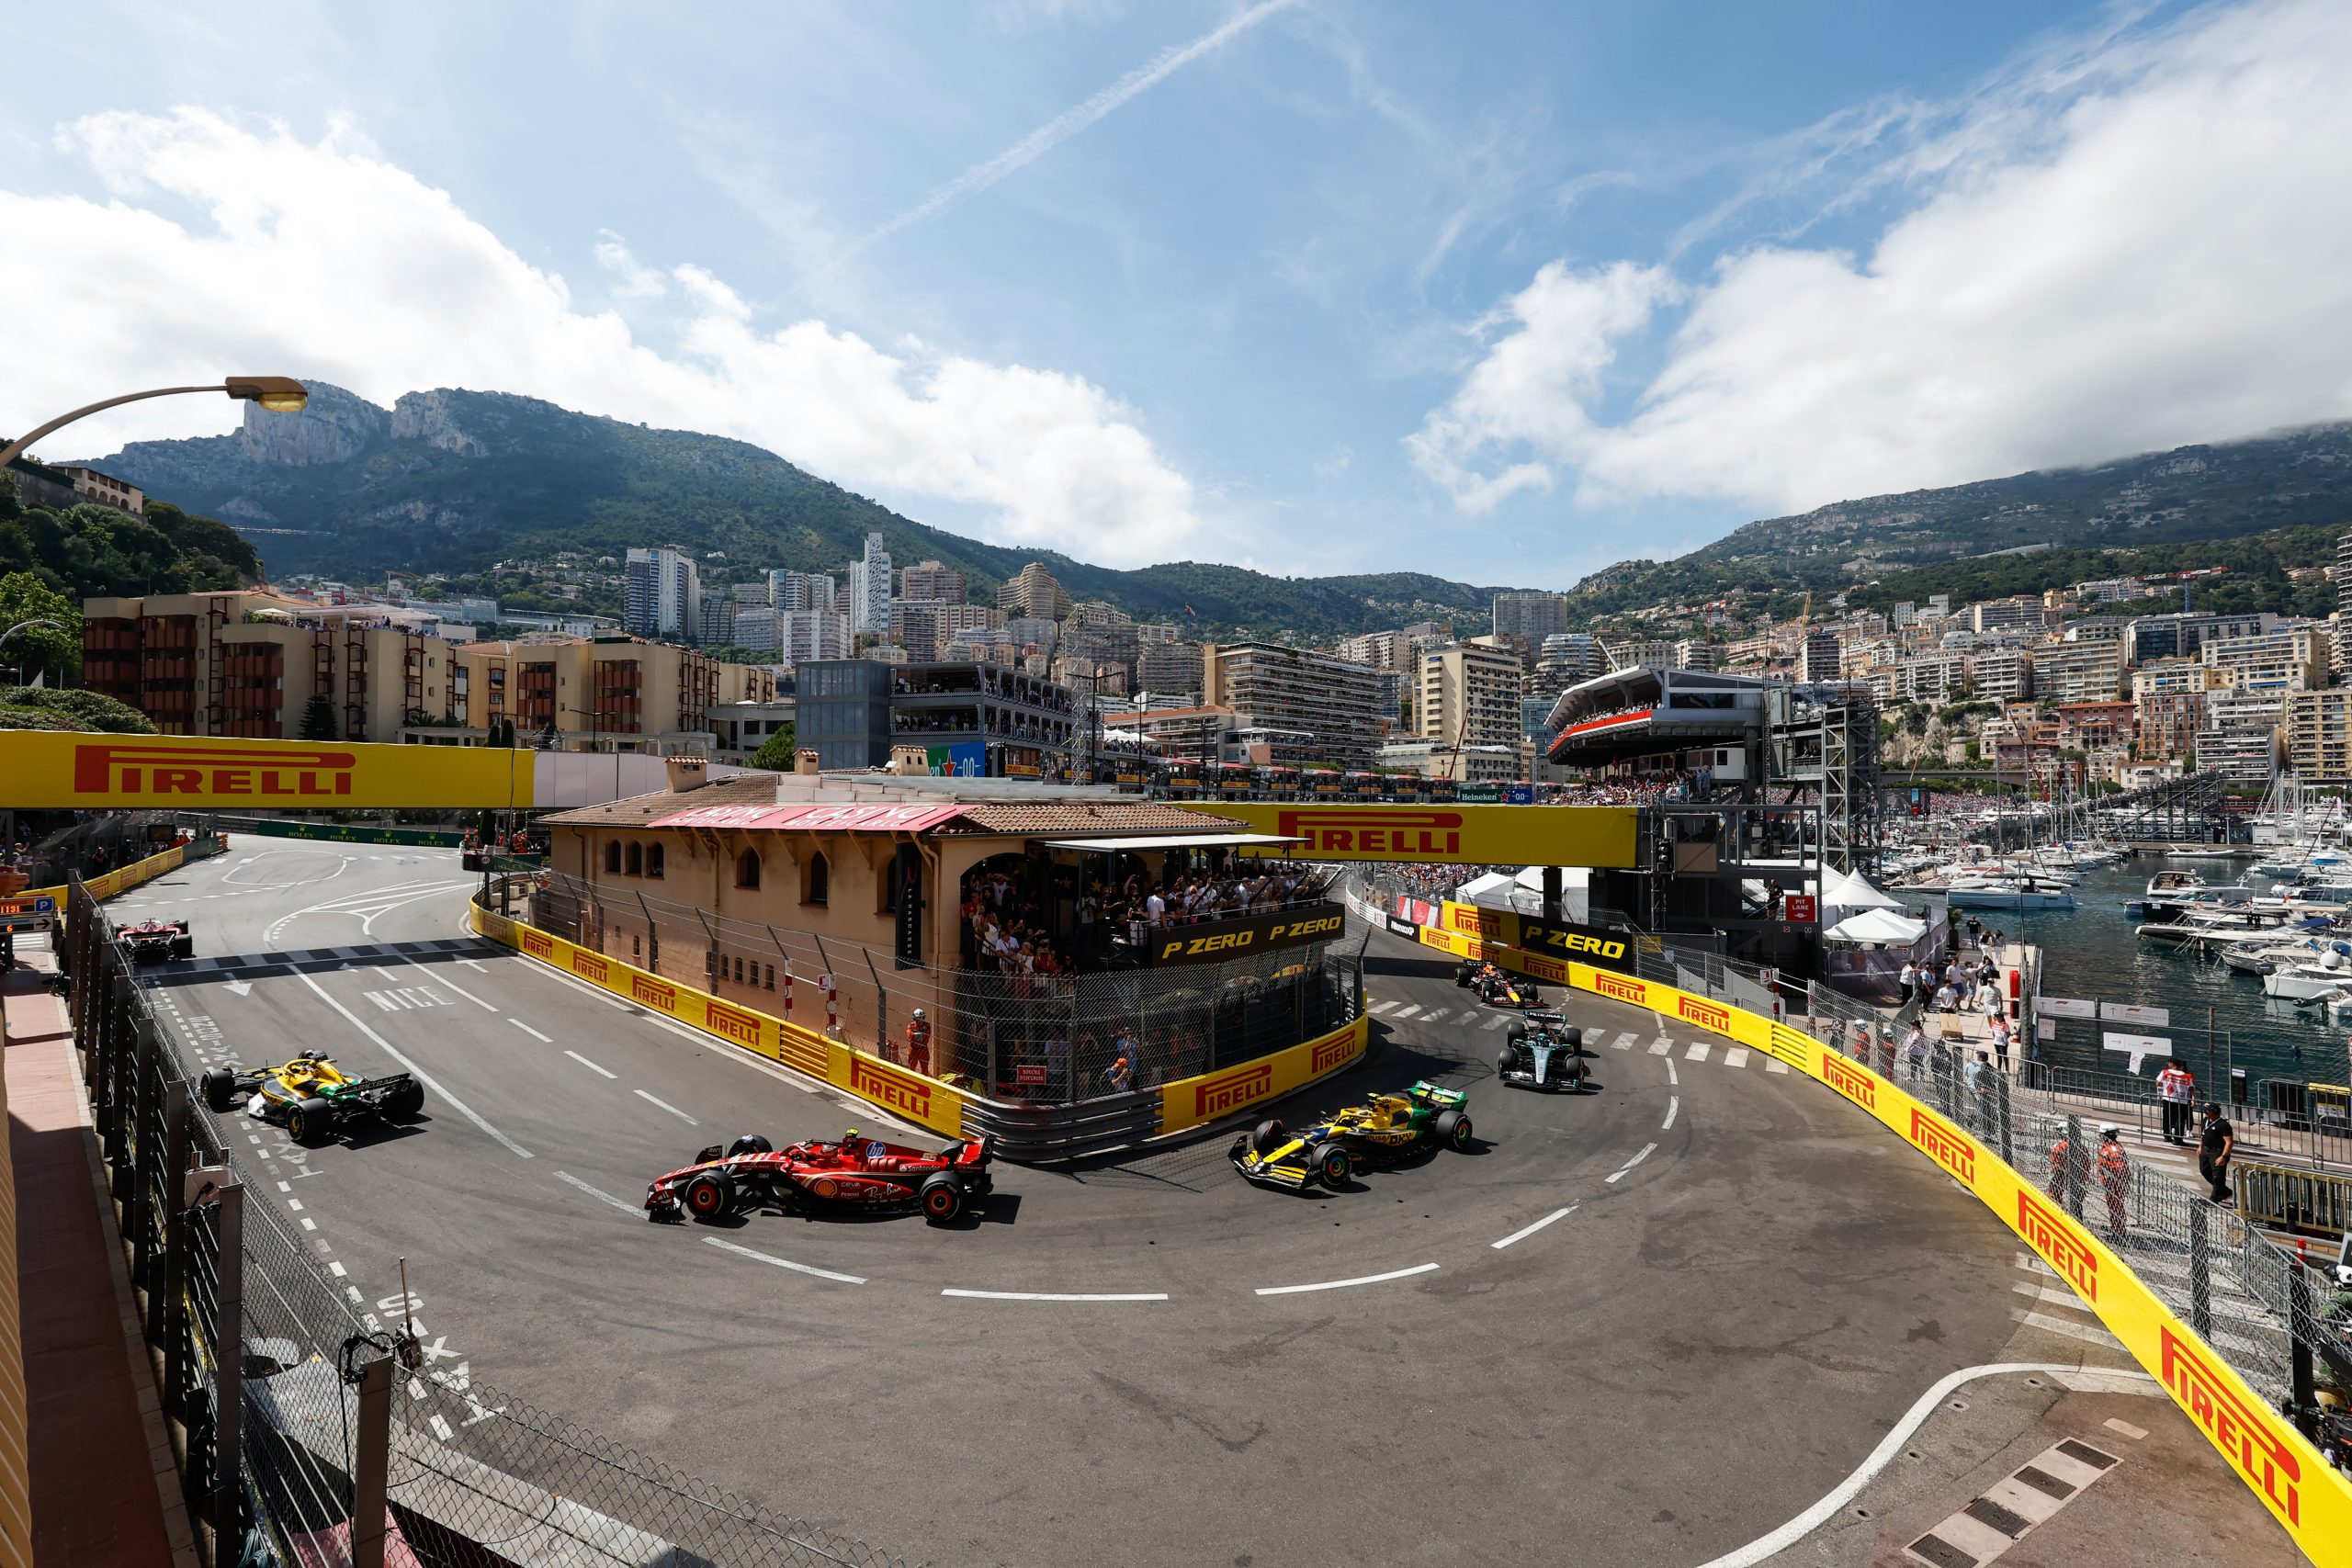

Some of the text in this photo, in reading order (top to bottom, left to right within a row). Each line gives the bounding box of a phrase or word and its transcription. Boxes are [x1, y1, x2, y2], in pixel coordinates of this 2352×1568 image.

[74, 744, 356, 795] PIRELLI
[806, 807, 937, 819] CASINO
[1462, 793, 1498, 801] Heineken
[1279, 811, 1463, 854] PIRELLI
[6, 924, 13, 932] 6
[483, 914, 508, 940] PIRELLI
[1269, 916, 1342, 941] P ZERO
[1427, 931, 1451, 949] PIRELLI
[1455, 908, 1500, 938] PIRELLI
[524, 930, 553, 960] PIRELLI
[1162, 931, 1254, 959] P ZERO
[1525, 926, 1543, 940] P
[1546, 930, 1625, 959] ZERO
[573, 950, 608, 984] PIRELLI
[1523, 955, 1566, 982] PIRELLI
[362, 986, 457, 1012] NICE
[632, 975, 675, 1012] PIRELLI
[1596, 974, 1646, 1004] PIRELLI
[707, 1001, 761, 1046] PIRELLI
[1679, 996, 1730, 1032] PIRELLI
[1311, 1029, 1355, 1074] PIRELLI
[850, 1056, 931, 1119] PIRELLI
[1196, 1064, 1272, 1118] PIRELLI
[1823, 1053, 1875, 1110] PIRELLI
[1911, 1107, 1975, 1185] PIRELLI
[2018, 1189, 2098, 1303] PIRELLI
[377, 1291, 508, 1427] TAXIS
[2161, 1325, 2301, 1529] PIRELLI
